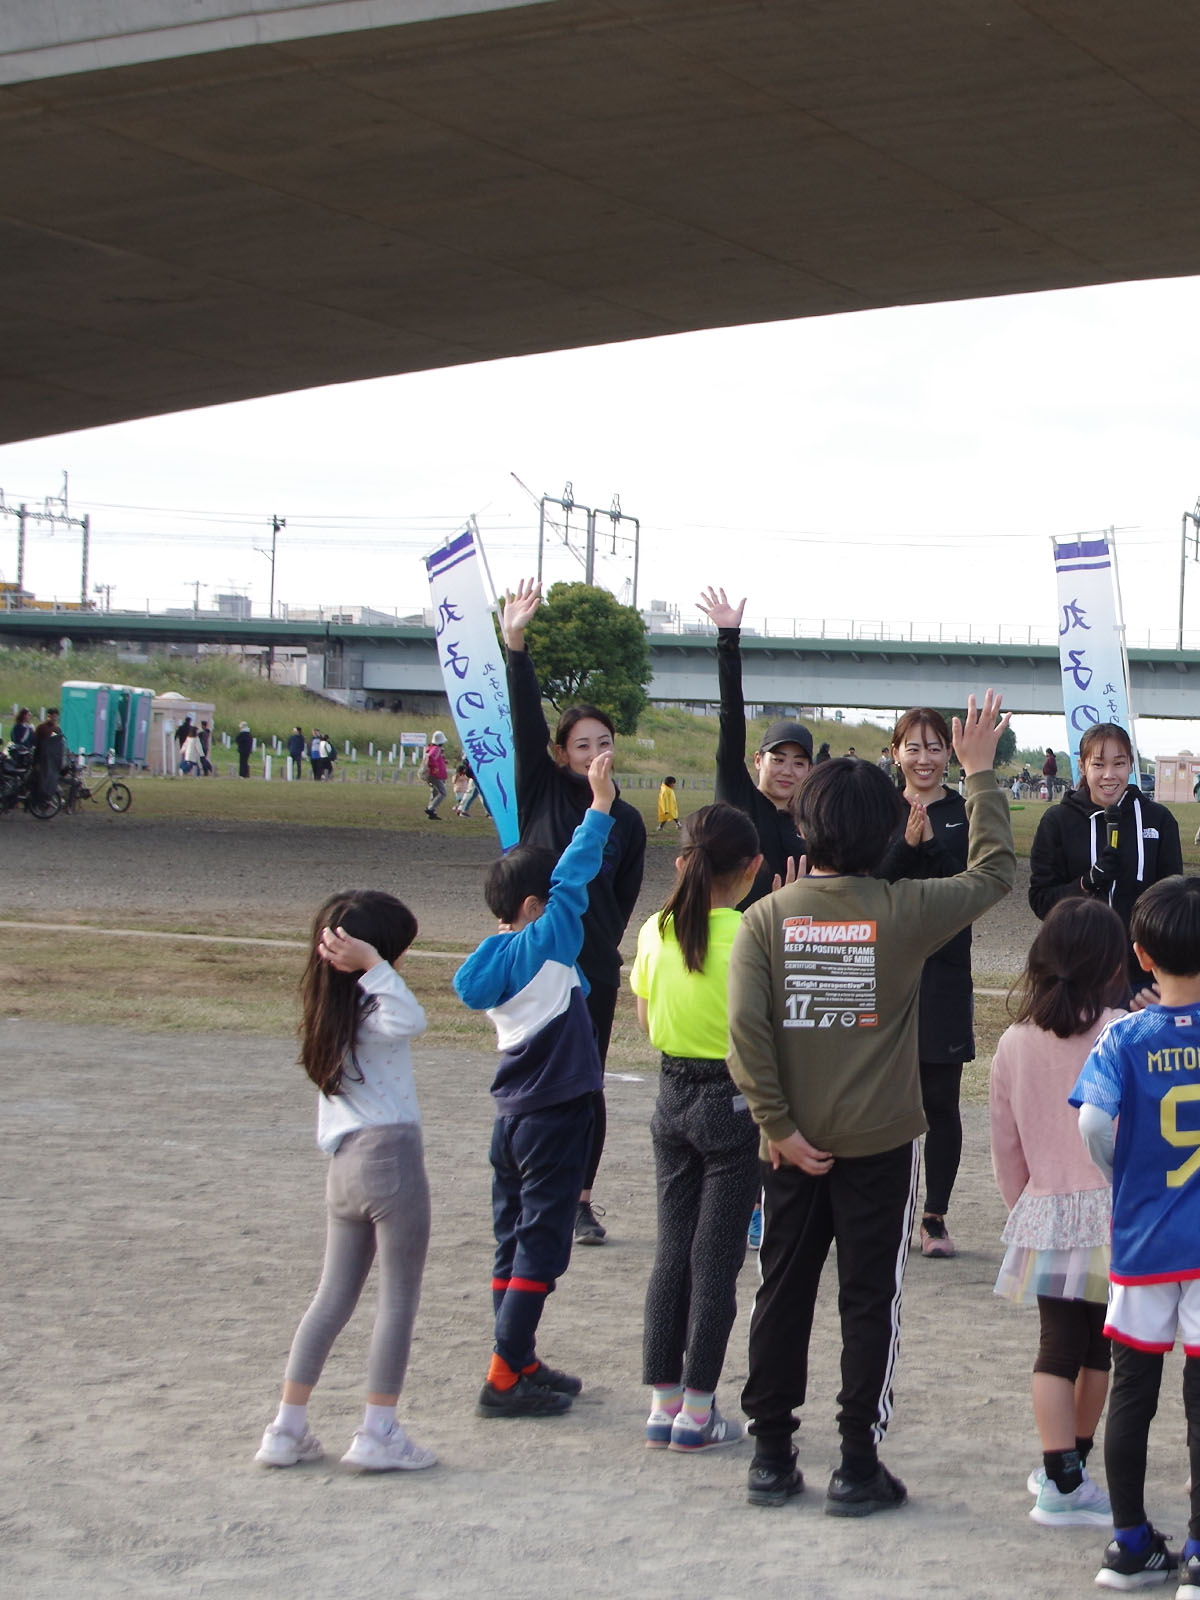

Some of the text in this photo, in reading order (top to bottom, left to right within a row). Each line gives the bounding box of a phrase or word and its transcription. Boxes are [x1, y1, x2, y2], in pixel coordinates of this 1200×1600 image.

[784, 924, 872, 943] FORWARD
[784, 943, 876, 955] KEEP A POSITIVE FRAME
[842, 954, 876, 964] OF MIND
[785, 993, 812, 1020] 17
